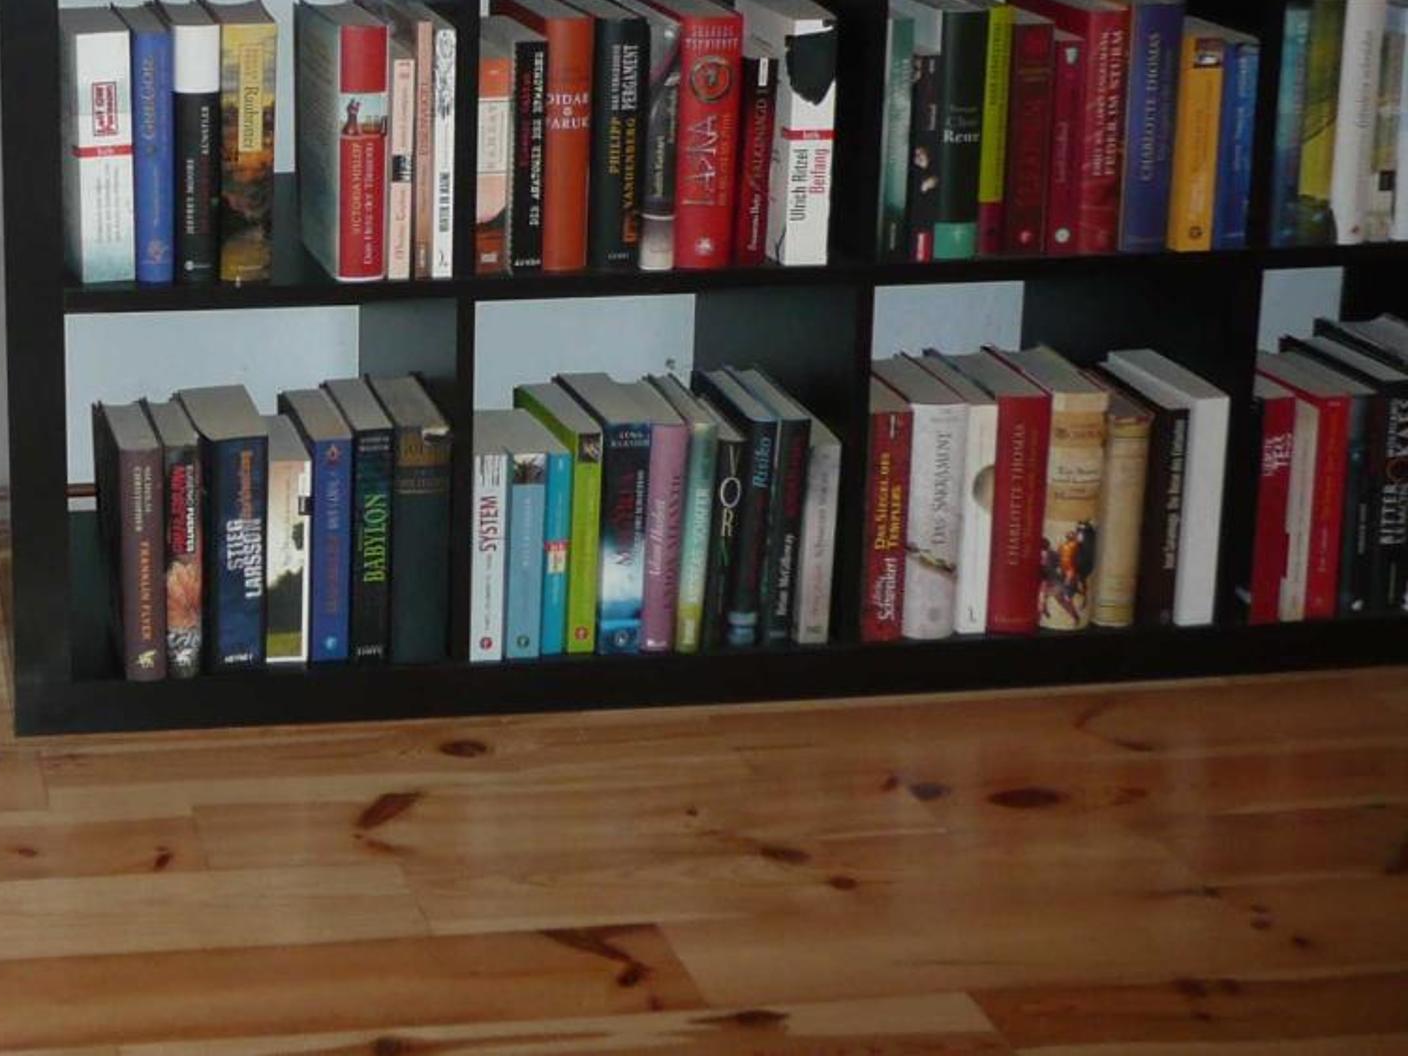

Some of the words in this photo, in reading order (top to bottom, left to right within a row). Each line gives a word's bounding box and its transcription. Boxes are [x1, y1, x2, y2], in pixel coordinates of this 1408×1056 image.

[622, 44, 638, 111] PERGAMENT
[1139, 97, 1155, 182] CHARLOTTE
[1147, 32, 1161, 92] THOMAS
[609, 116, 621, 174] PHILIPP
[622, 116, 637, 209] VANDENBERG
[789, 148, 807, 183] Ritzel
[789, 186, 807, 222] Ulrich
[751, 436, 772, 488] Risiko
[931, 430, 951, 512] SAKRAMENT
[227, 518, 243, 572] STIEG
[363, 494, 387, 583] BABYLON
[479, 495, 497, 552] SYSTEM
[1006, 485, 1019, 565] CHARLOTTE
[140, 541, 153, 601] FRANKLIN
[245, 518, 262, 598] LARSSON
